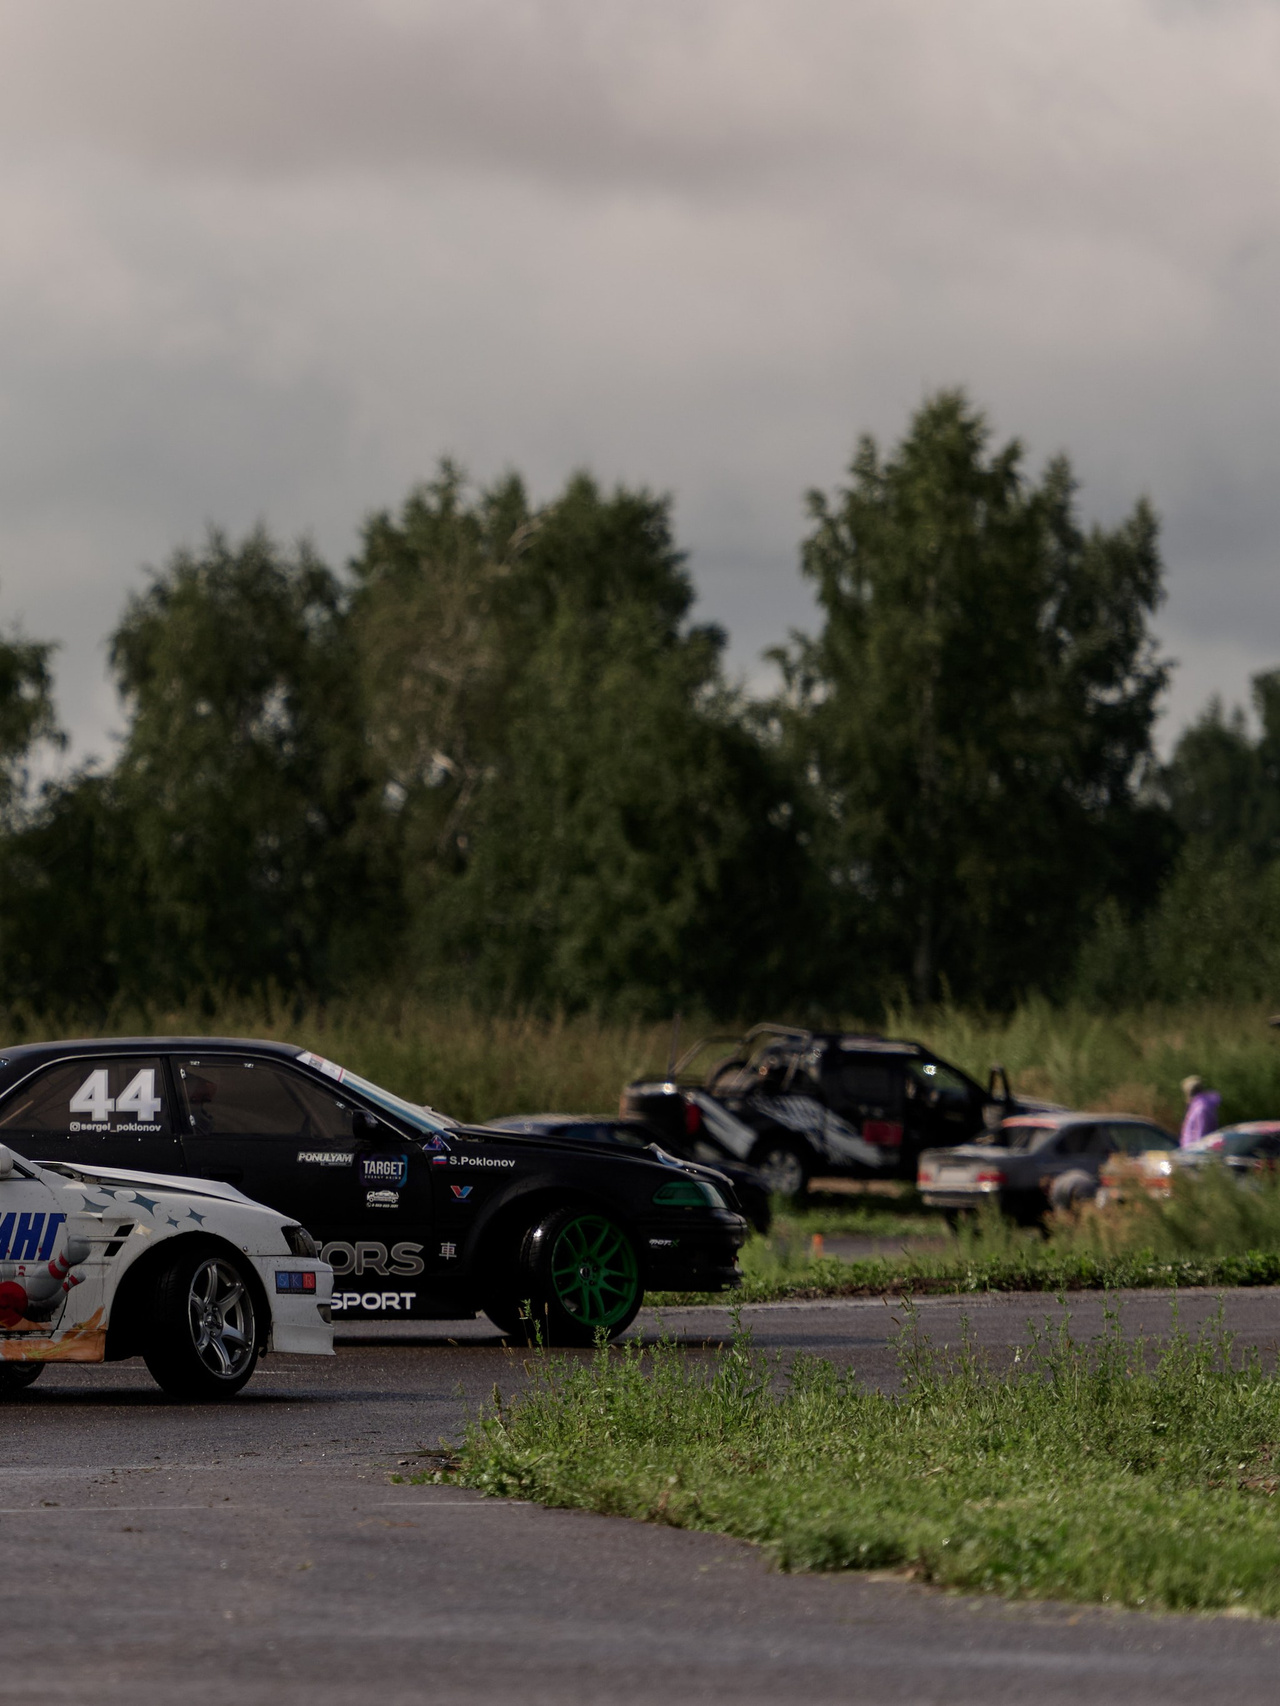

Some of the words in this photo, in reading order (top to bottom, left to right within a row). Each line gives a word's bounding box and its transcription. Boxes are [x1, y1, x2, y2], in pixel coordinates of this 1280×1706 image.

[69, 1068, 161, 1122] 44
[297, 1152, 353, 1163] PONULYAM
[449, 1156, 516, 1168] S.Poklonov
[363, 1160, 404, 1176] TARGET
[279, 1273, 313, 1287] SKR
[331, 1292, 417, 1310] SPORT
